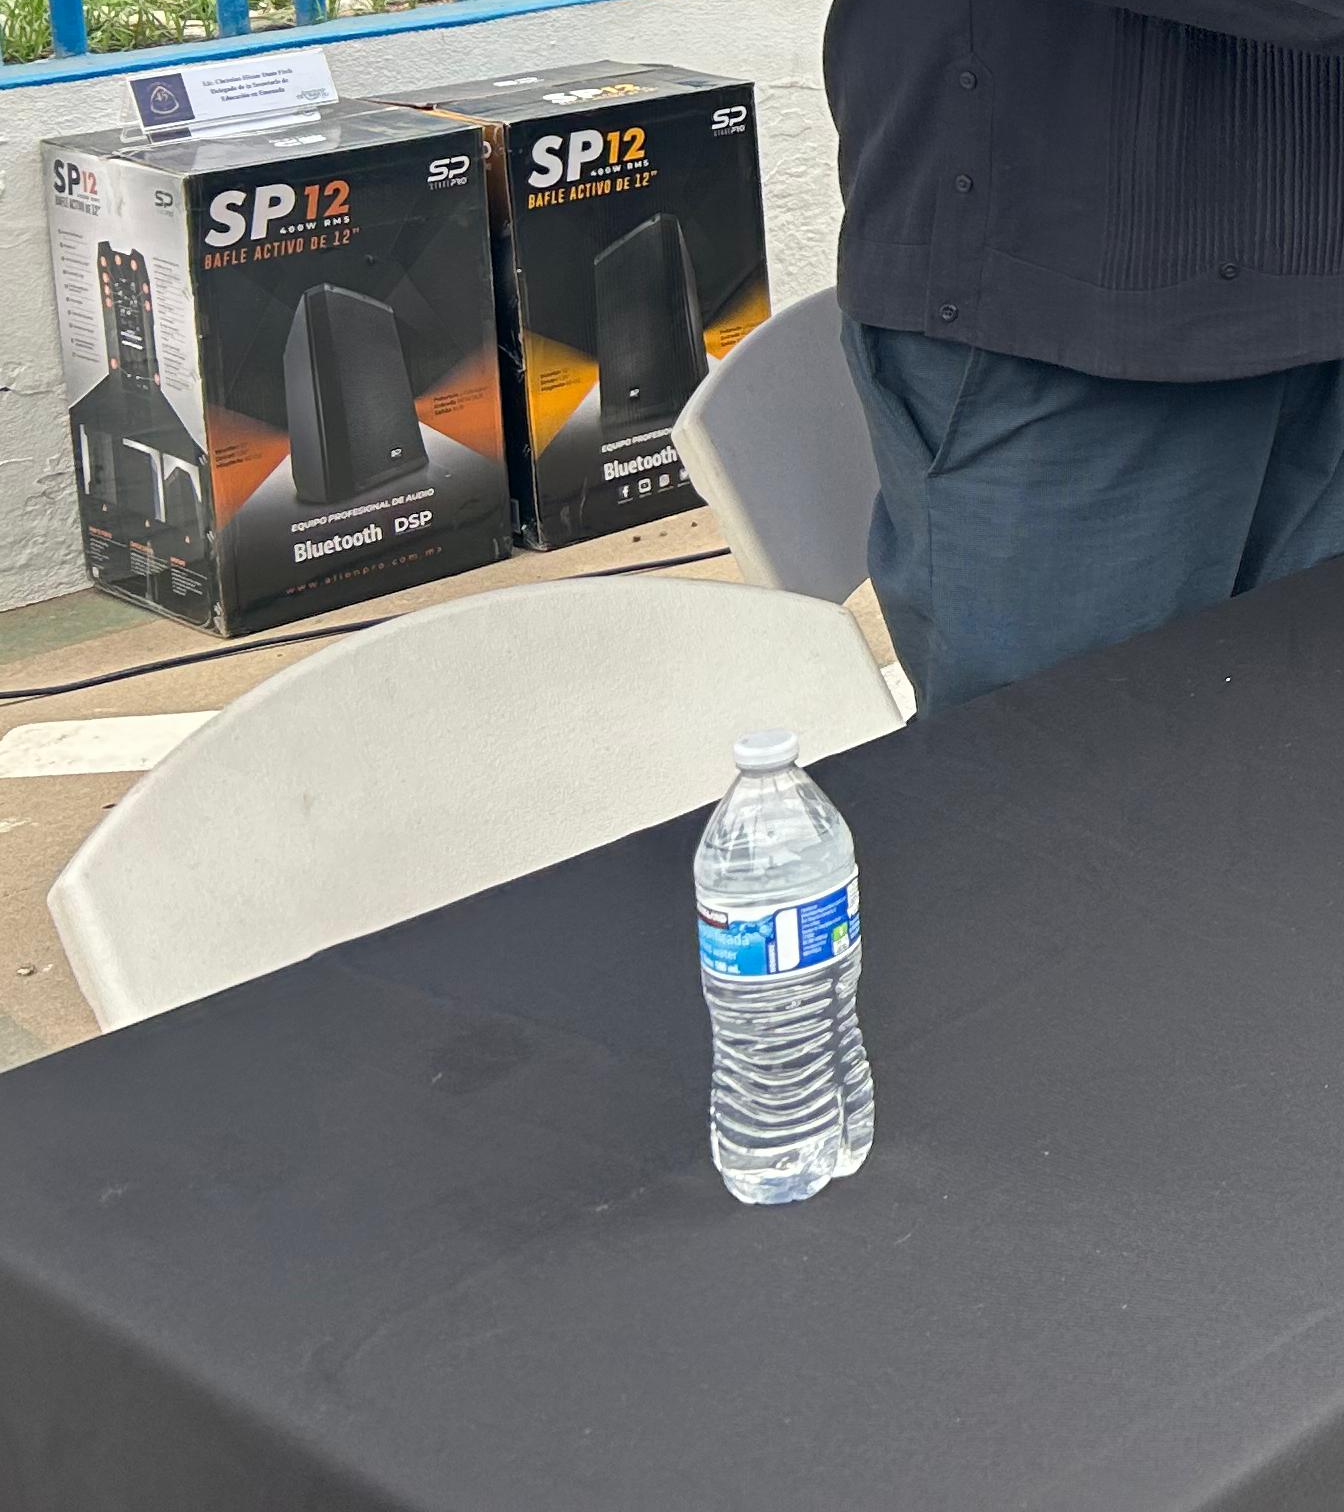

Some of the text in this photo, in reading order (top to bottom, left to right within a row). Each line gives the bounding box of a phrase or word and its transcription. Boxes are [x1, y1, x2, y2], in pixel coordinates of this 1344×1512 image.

[590, 159, 650, 177] 400W RMS
[528, 188, 565, 210] BAFLE
[569, 179, 611, 201] ACTIVO
[616, 176, 630, 191] DE
[279, 215, 351, 235] 400W RMS
[204, 247, 248, 270] BAFLE
[253, 237, 304, 261] ACTIVO
[310, 234, 327, 250] DE
[601, 438, 632, 453] EQUIPO
[604, 445, 678, 481] Bluetooth
[291, 488, 435, 533] EQUIPO PROFESIONAL DE AUDIO
[293, 510, 433, 563] Bluetooth DSP
